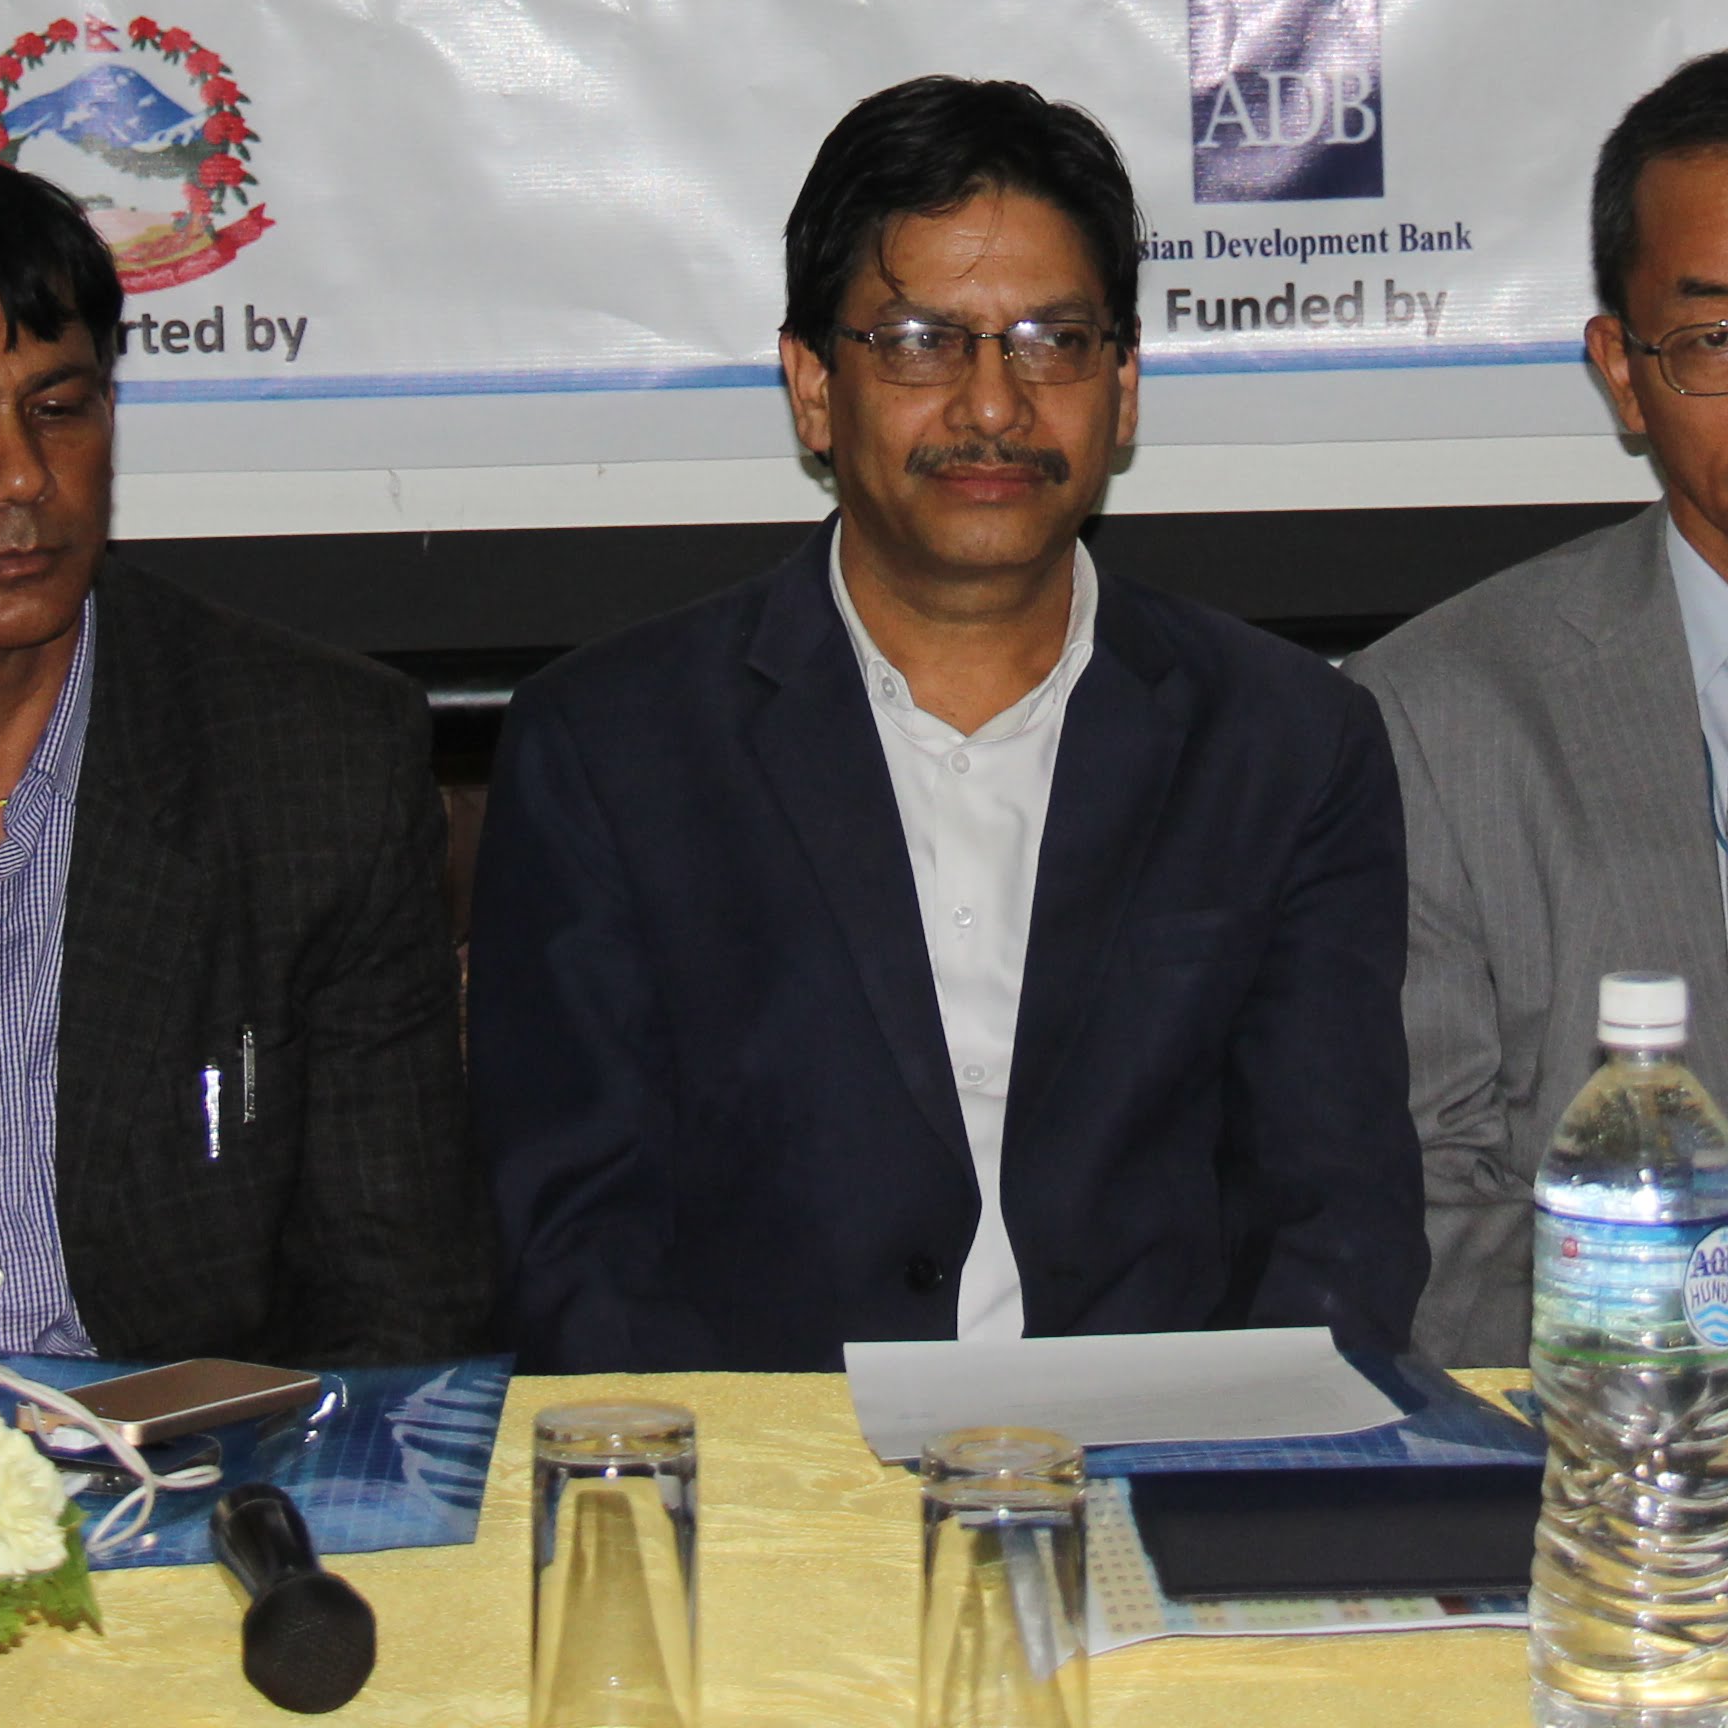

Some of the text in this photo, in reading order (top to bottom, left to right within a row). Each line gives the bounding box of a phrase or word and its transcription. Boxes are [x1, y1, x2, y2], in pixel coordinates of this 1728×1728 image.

[1197, 71, 1377, 147] ADB
[1138, 221, 1473, 263] sian Development Bank
[245, 304, 308, 362] by
[1166, 279, 1448, 337] Funded by
